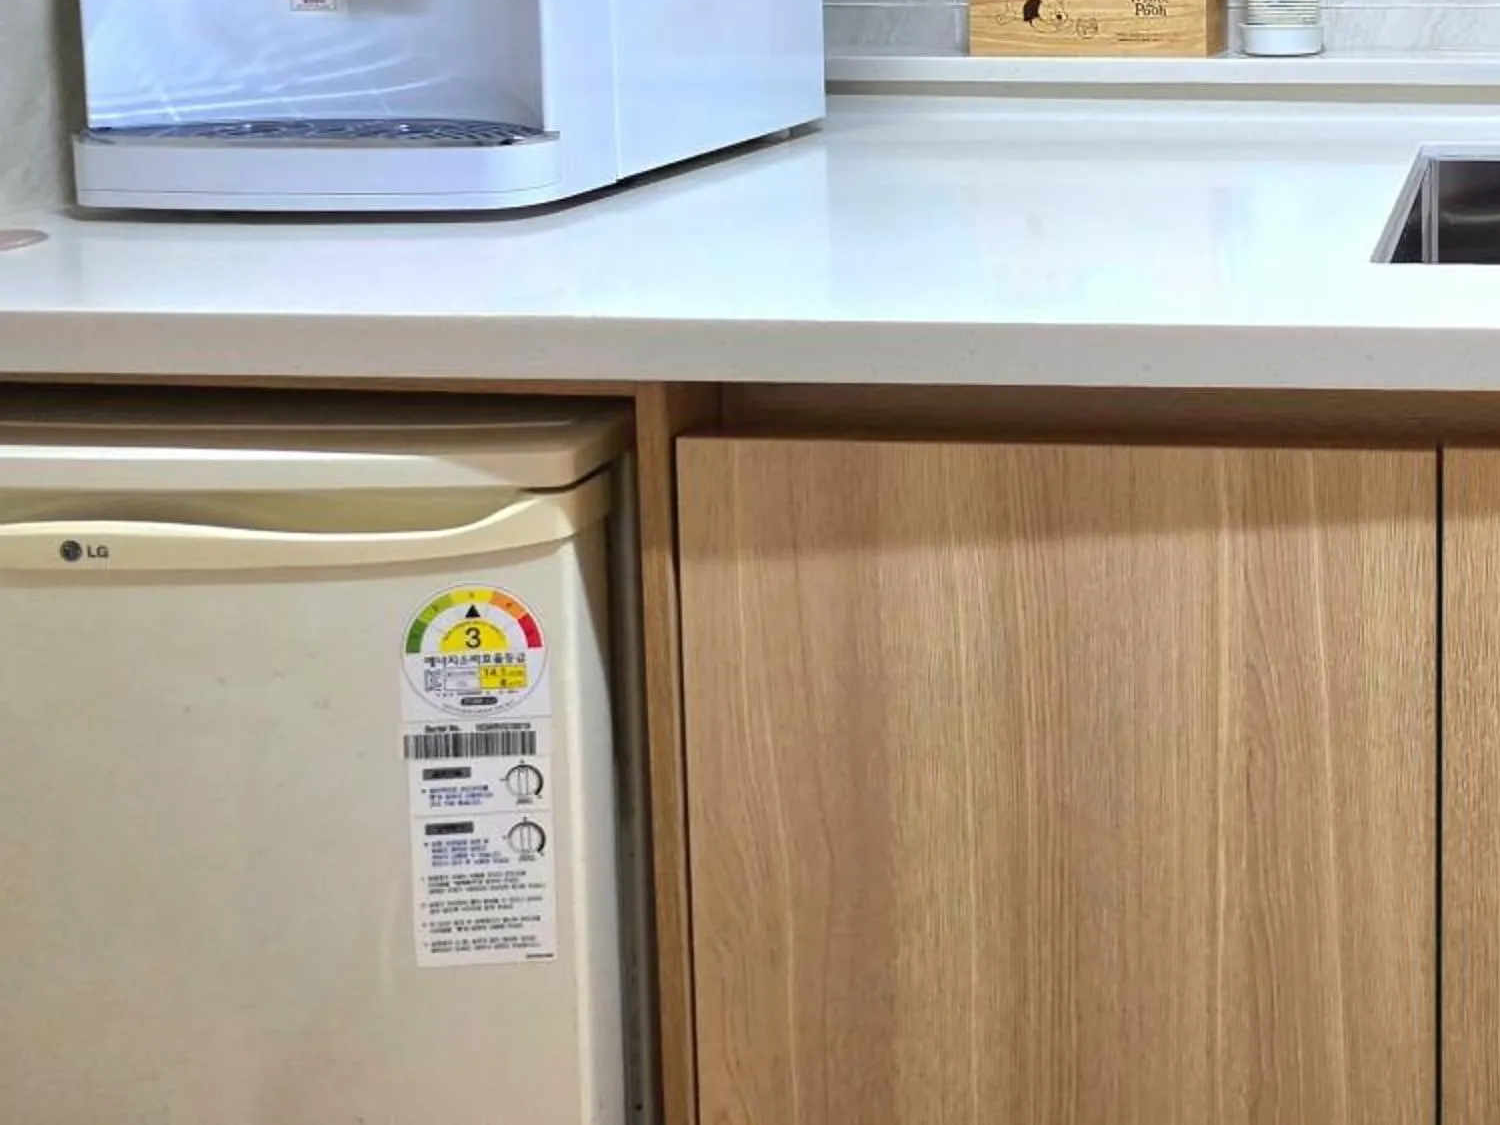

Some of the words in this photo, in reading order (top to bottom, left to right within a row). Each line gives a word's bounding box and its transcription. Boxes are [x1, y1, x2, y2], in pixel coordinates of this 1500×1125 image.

[1135, 3, 1167, 16] Pooh
[87, 544, 109, 558] LG
[465, 627, 481, 648] 3
